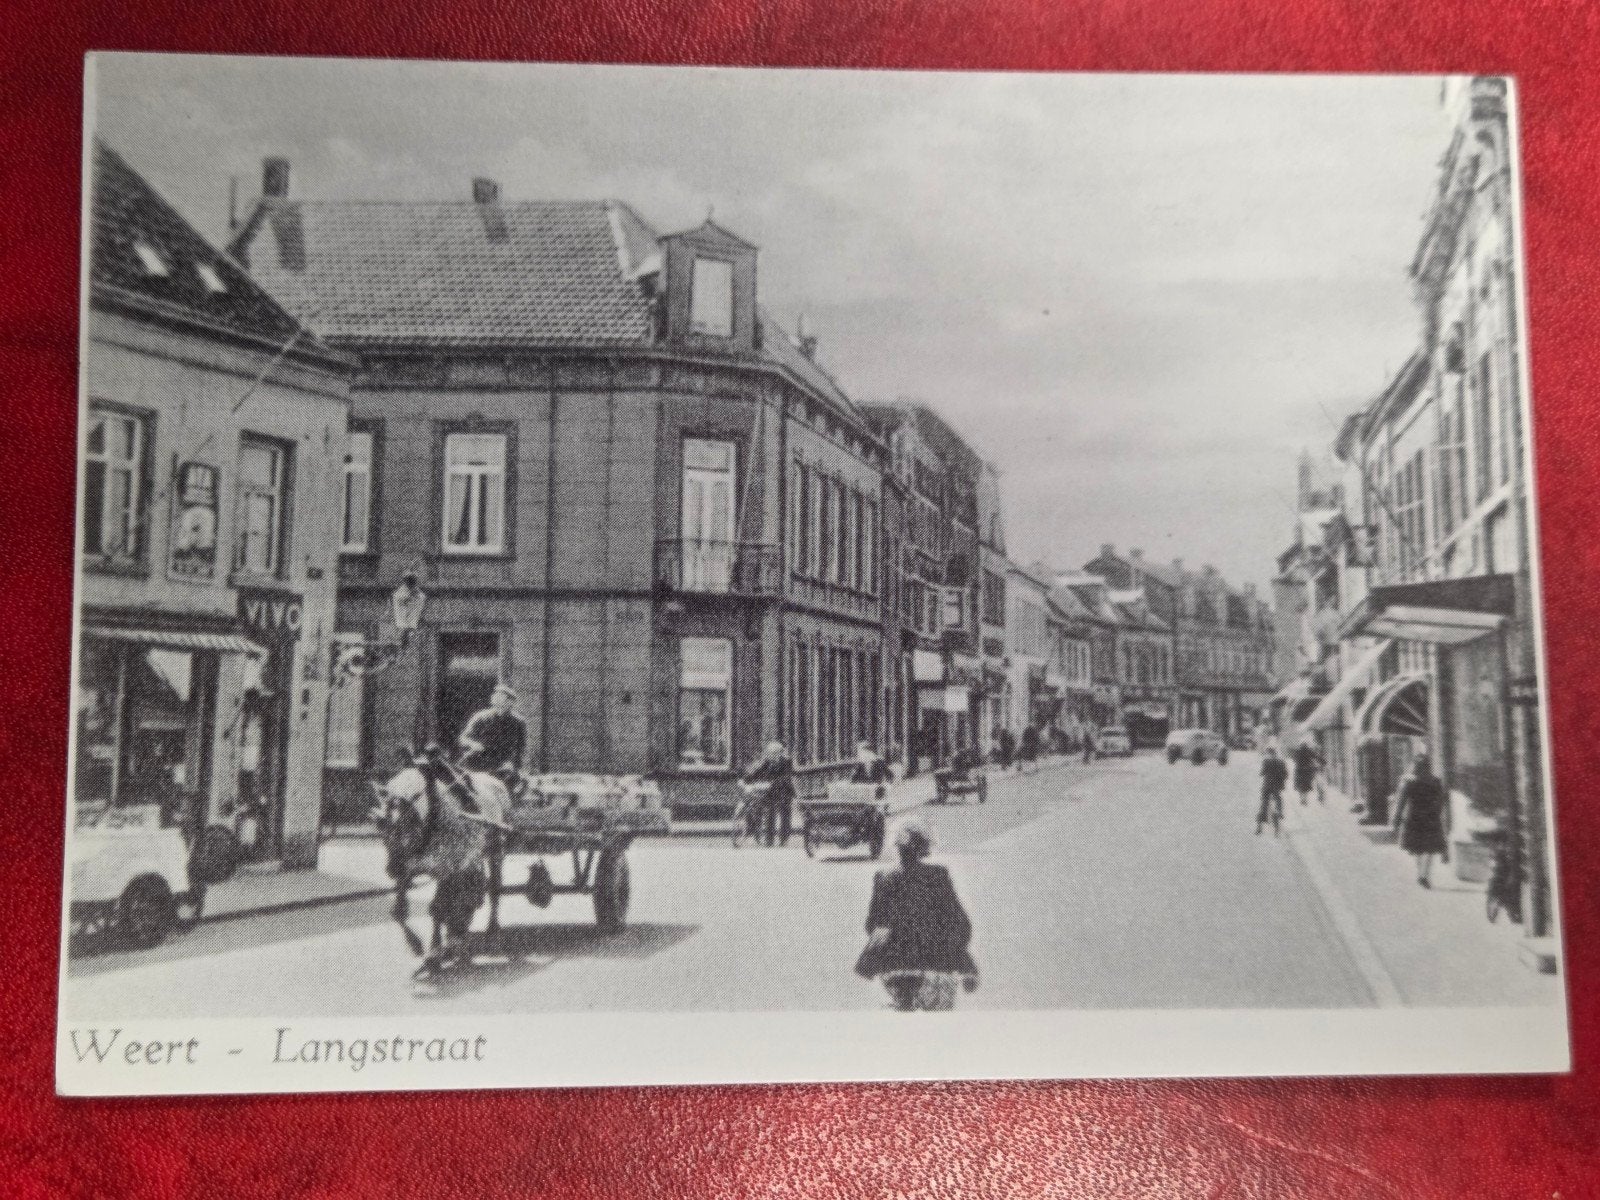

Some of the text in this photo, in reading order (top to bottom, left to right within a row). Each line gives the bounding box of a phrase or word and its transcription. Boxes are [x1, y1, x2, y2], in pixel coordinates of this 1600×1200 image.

[244, 599, 302, 632] VIVO
[69, 1028, 199, 1065] Weert
[271, 1027, 487, 1072] Langstraat
